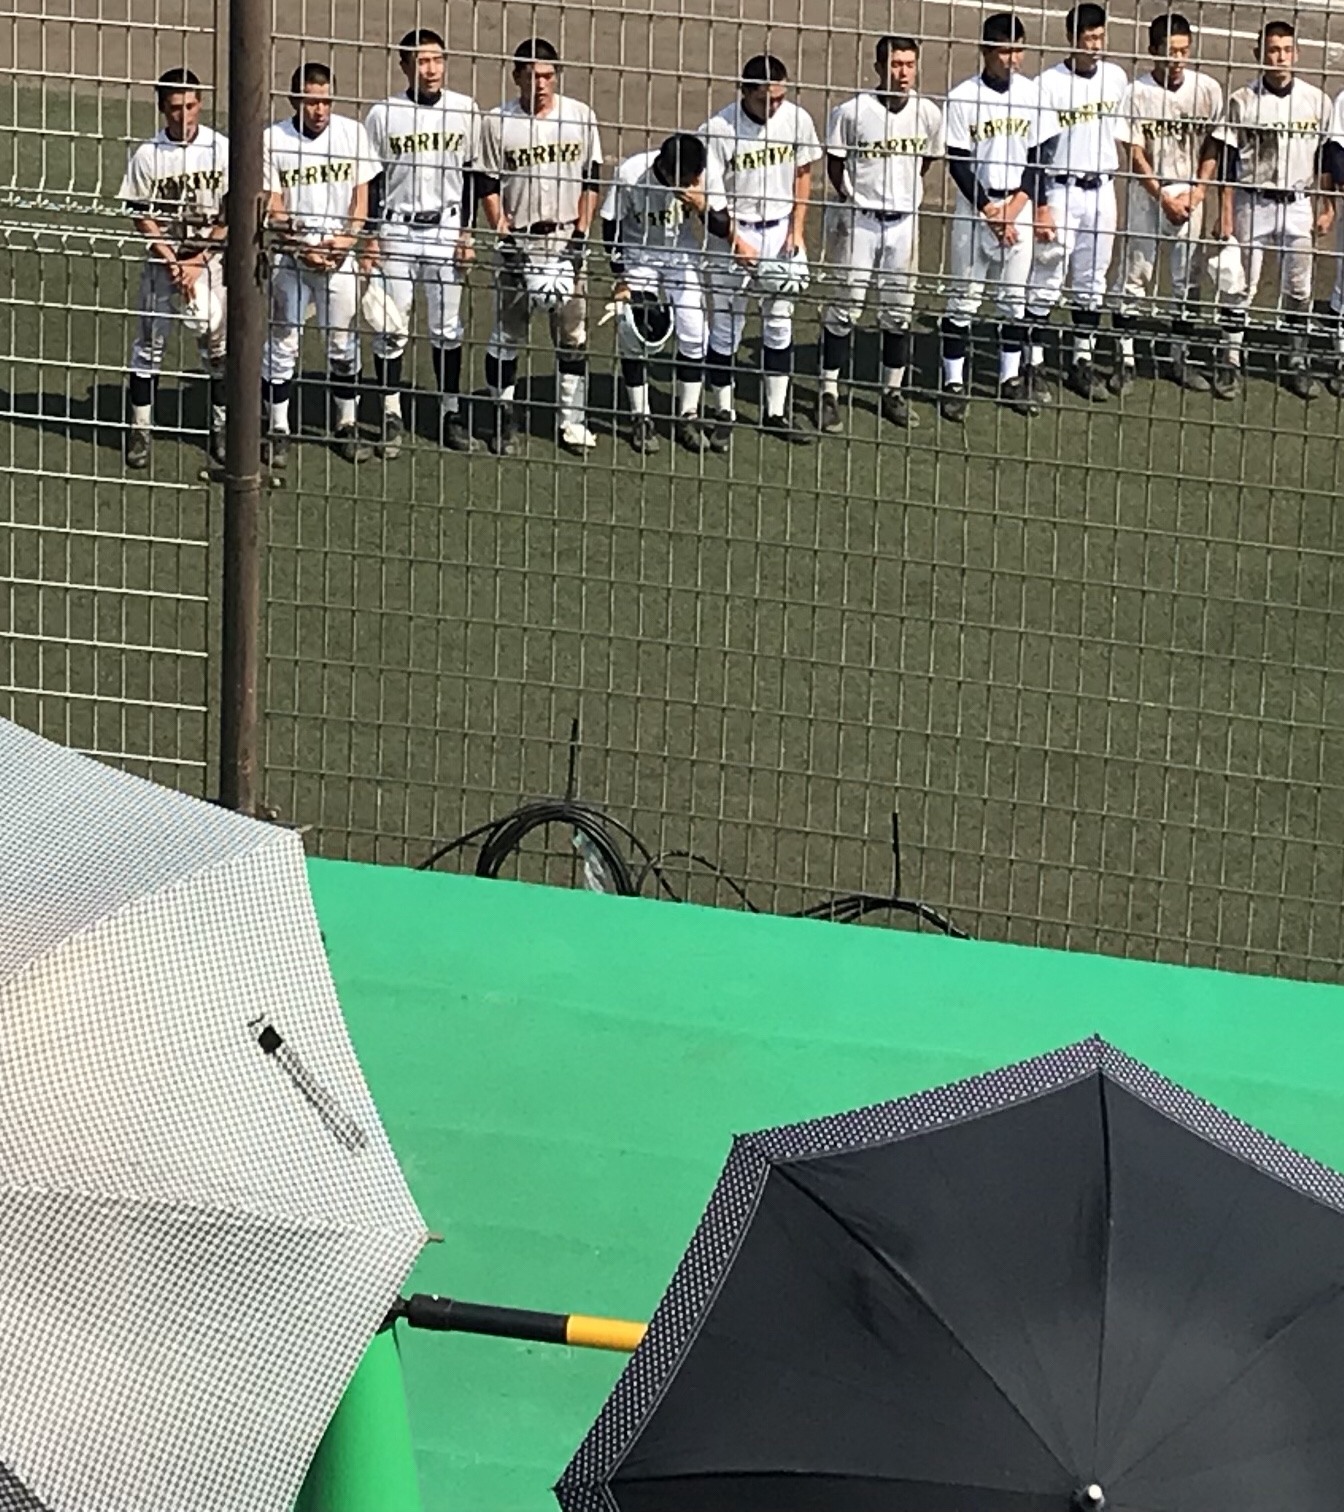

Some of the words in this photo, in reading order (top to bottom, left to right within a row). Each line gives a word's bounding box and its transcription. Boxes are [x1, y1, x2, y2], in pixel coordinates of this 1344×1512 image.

[389, 132, 465, 155] KARIYA
[503, 143, 582, 171] KARIYA
[279, 162, 354, 189] KARIYA
